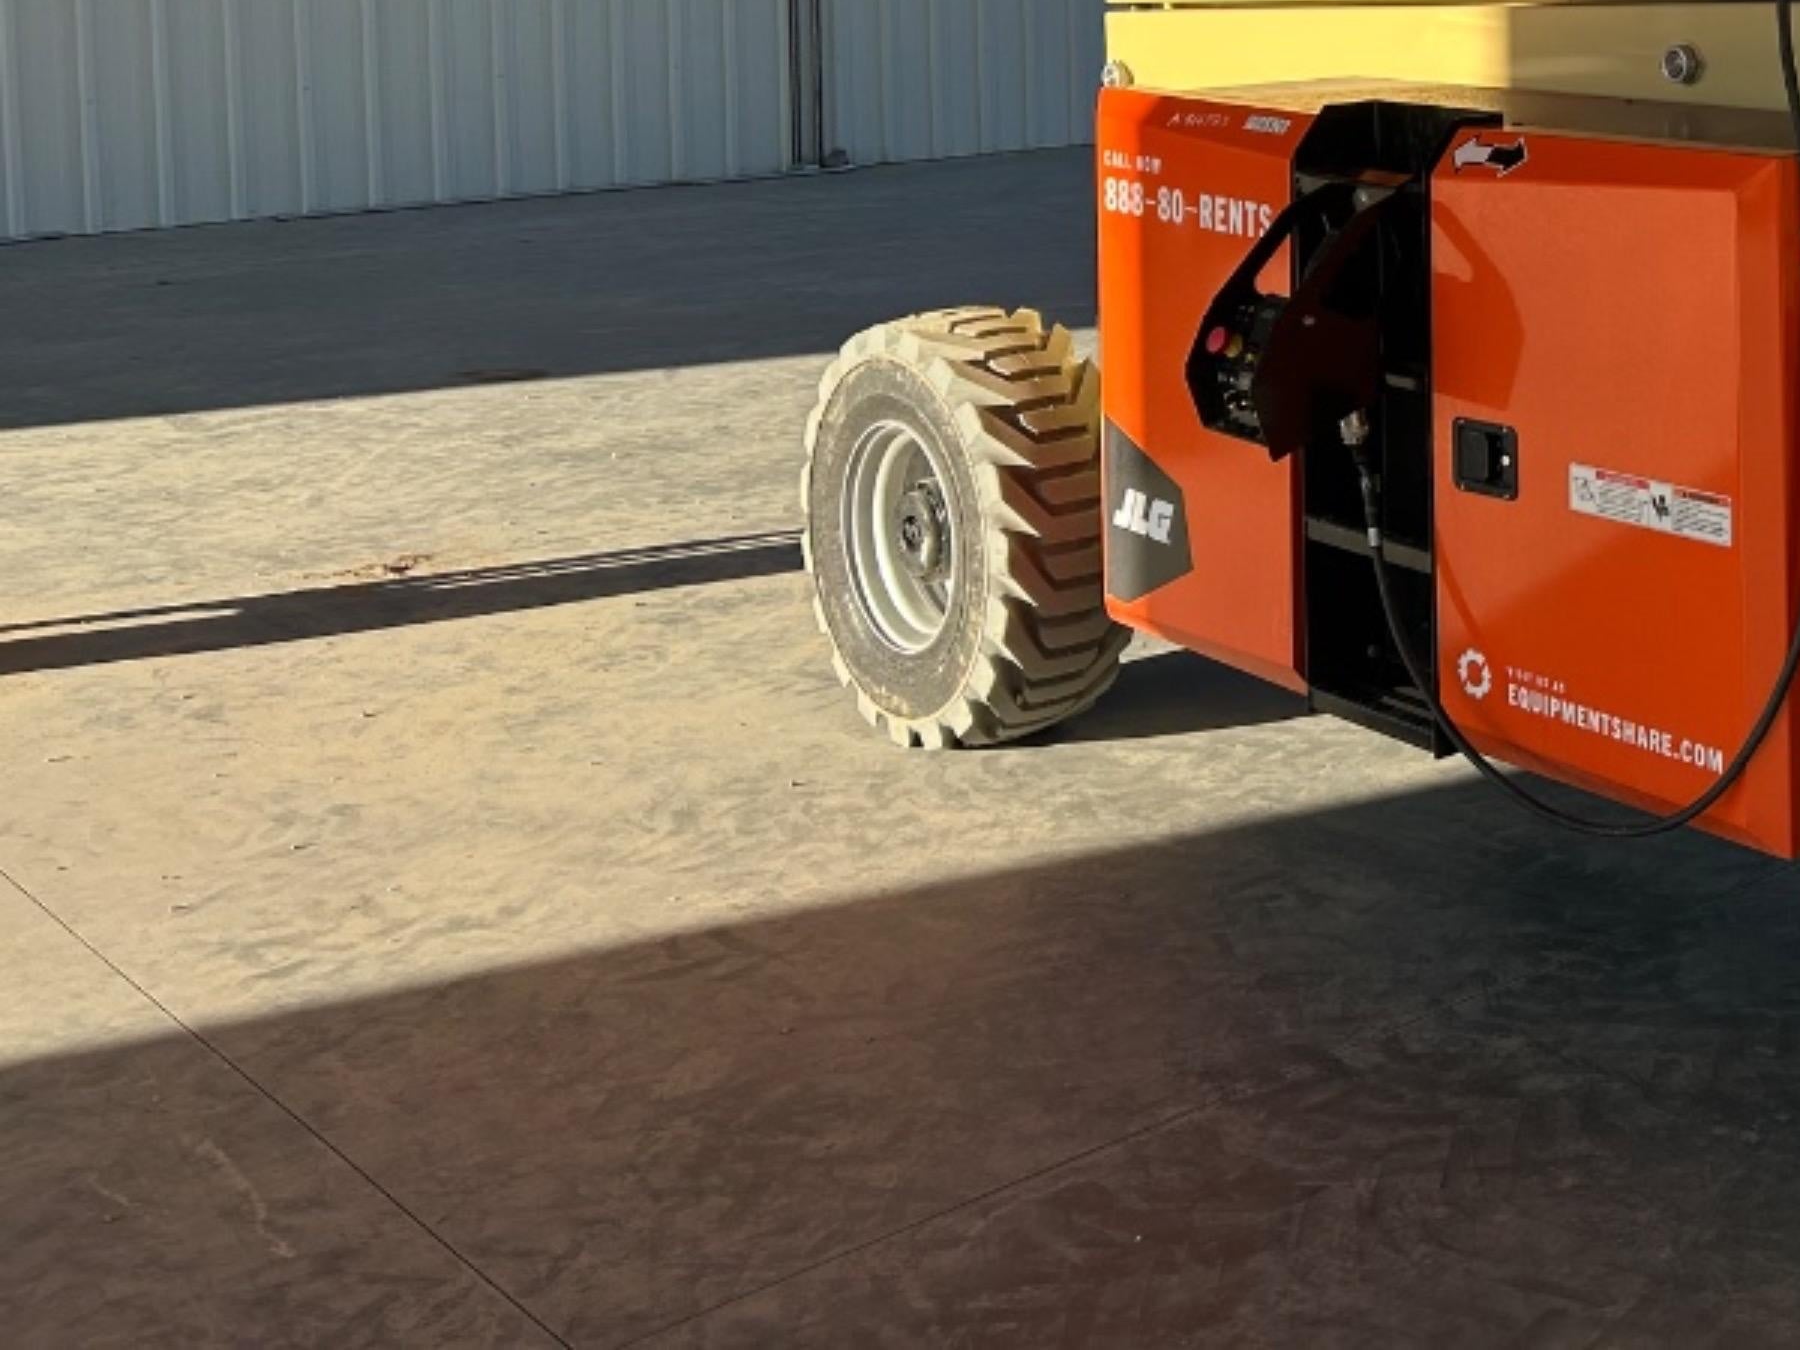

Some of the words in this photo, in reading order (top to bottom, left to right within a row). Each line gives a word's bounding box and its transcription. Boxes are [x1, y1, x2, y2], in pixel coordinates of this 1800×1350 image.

[1103, 176, 1274, 238] 888-80-RENTS
[1112, 487, 1175, 546] JLG
[1508, 682, 1724, 776] EQUIPMENTSHARE.COM
